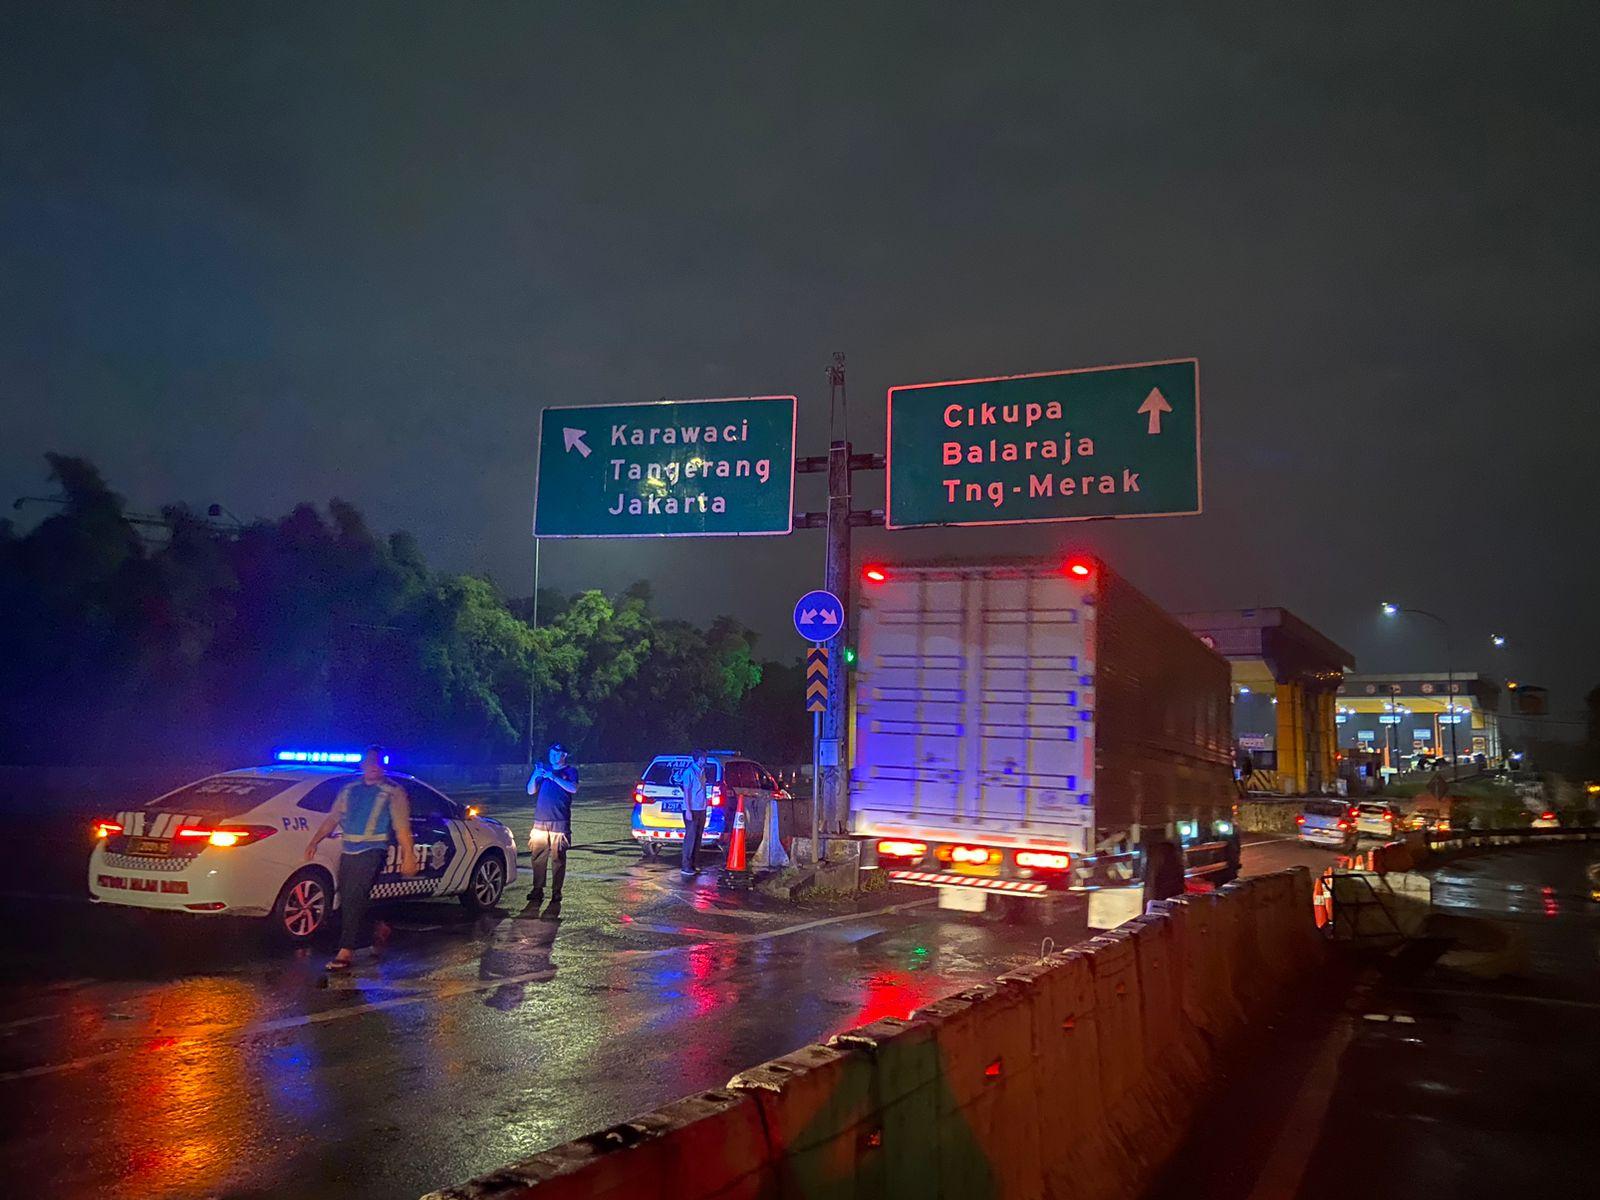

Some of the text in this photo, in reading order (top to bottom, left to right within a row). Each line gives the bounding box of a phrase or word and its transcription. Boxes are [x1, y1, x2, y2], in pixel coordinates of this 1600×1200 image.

[943, 401, 1063, 428] Cikupa
[610, 418, 748, 446] Karawaci
[943, 431, 1094, 466] Balaraja
[610, 458, 770, 486] Tangerang
[942, 468, 1141, 508] Tng-Merak
[608, 492, 726, 515] Jakarta
[281, 816, 310, 831] PJR
